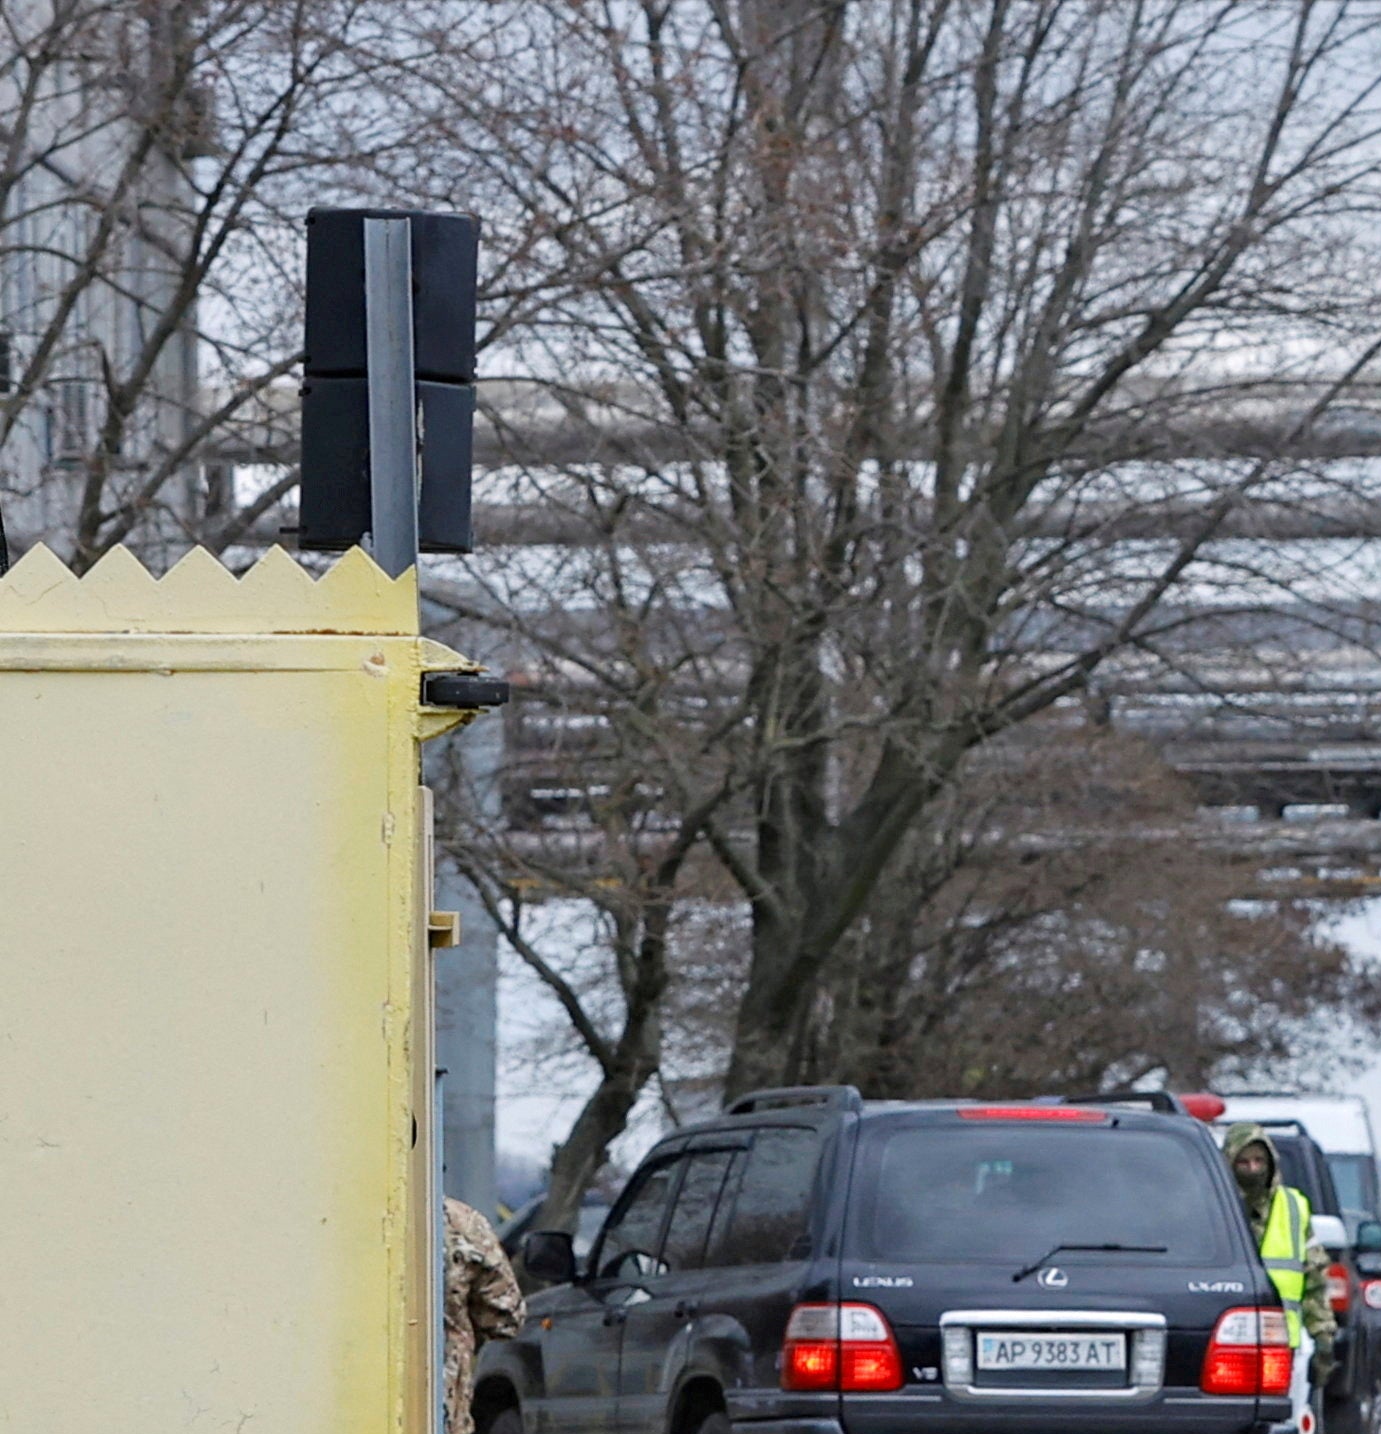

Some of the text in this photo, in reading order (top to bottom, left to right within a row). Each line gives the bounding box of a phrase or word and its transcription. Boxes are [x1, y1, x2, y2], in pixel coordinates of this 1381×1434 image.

[853, 1276, 914, 1288] LEXUS
[996, 1341, 1116, 1364] AP 9383 AT
